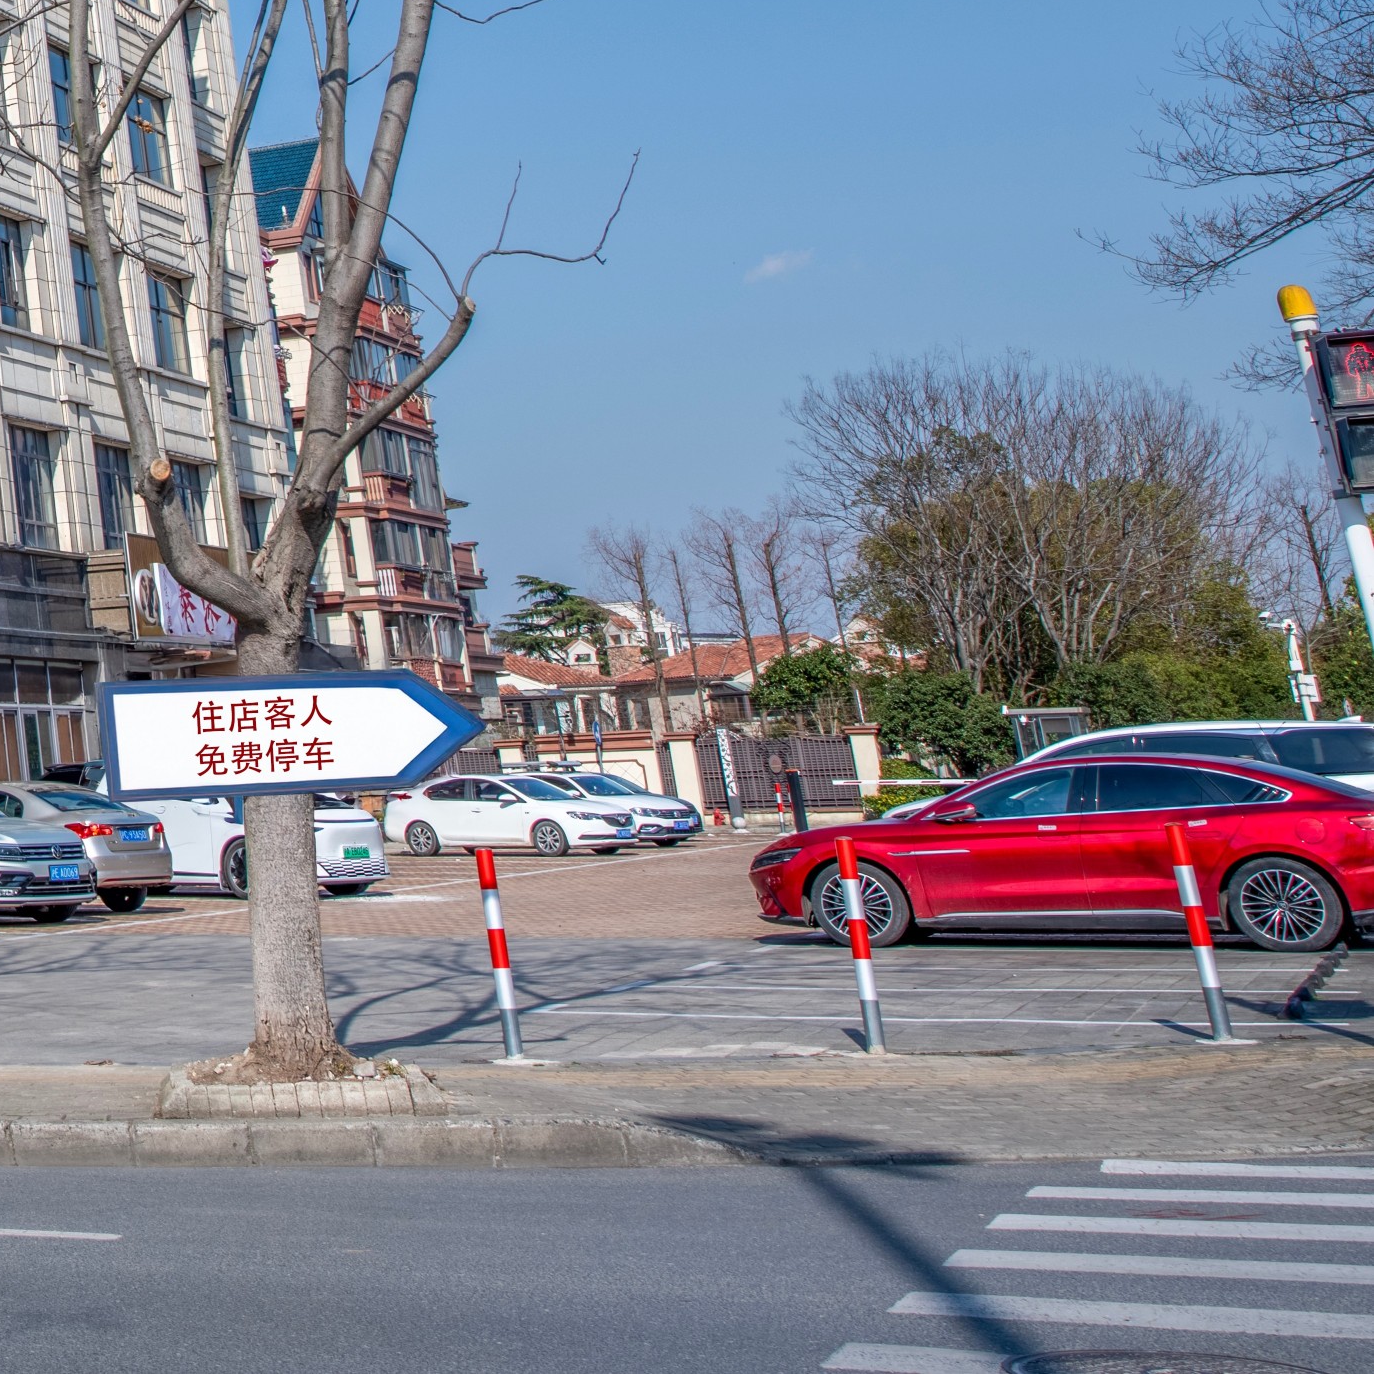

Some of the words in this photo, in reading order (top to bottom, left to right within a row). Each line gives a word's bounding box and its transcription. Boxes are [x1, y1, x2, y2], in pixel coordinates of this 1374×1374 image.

[192, 695, 333, 734] 住店客人
[195, 737, 335, 776] 免费停车
